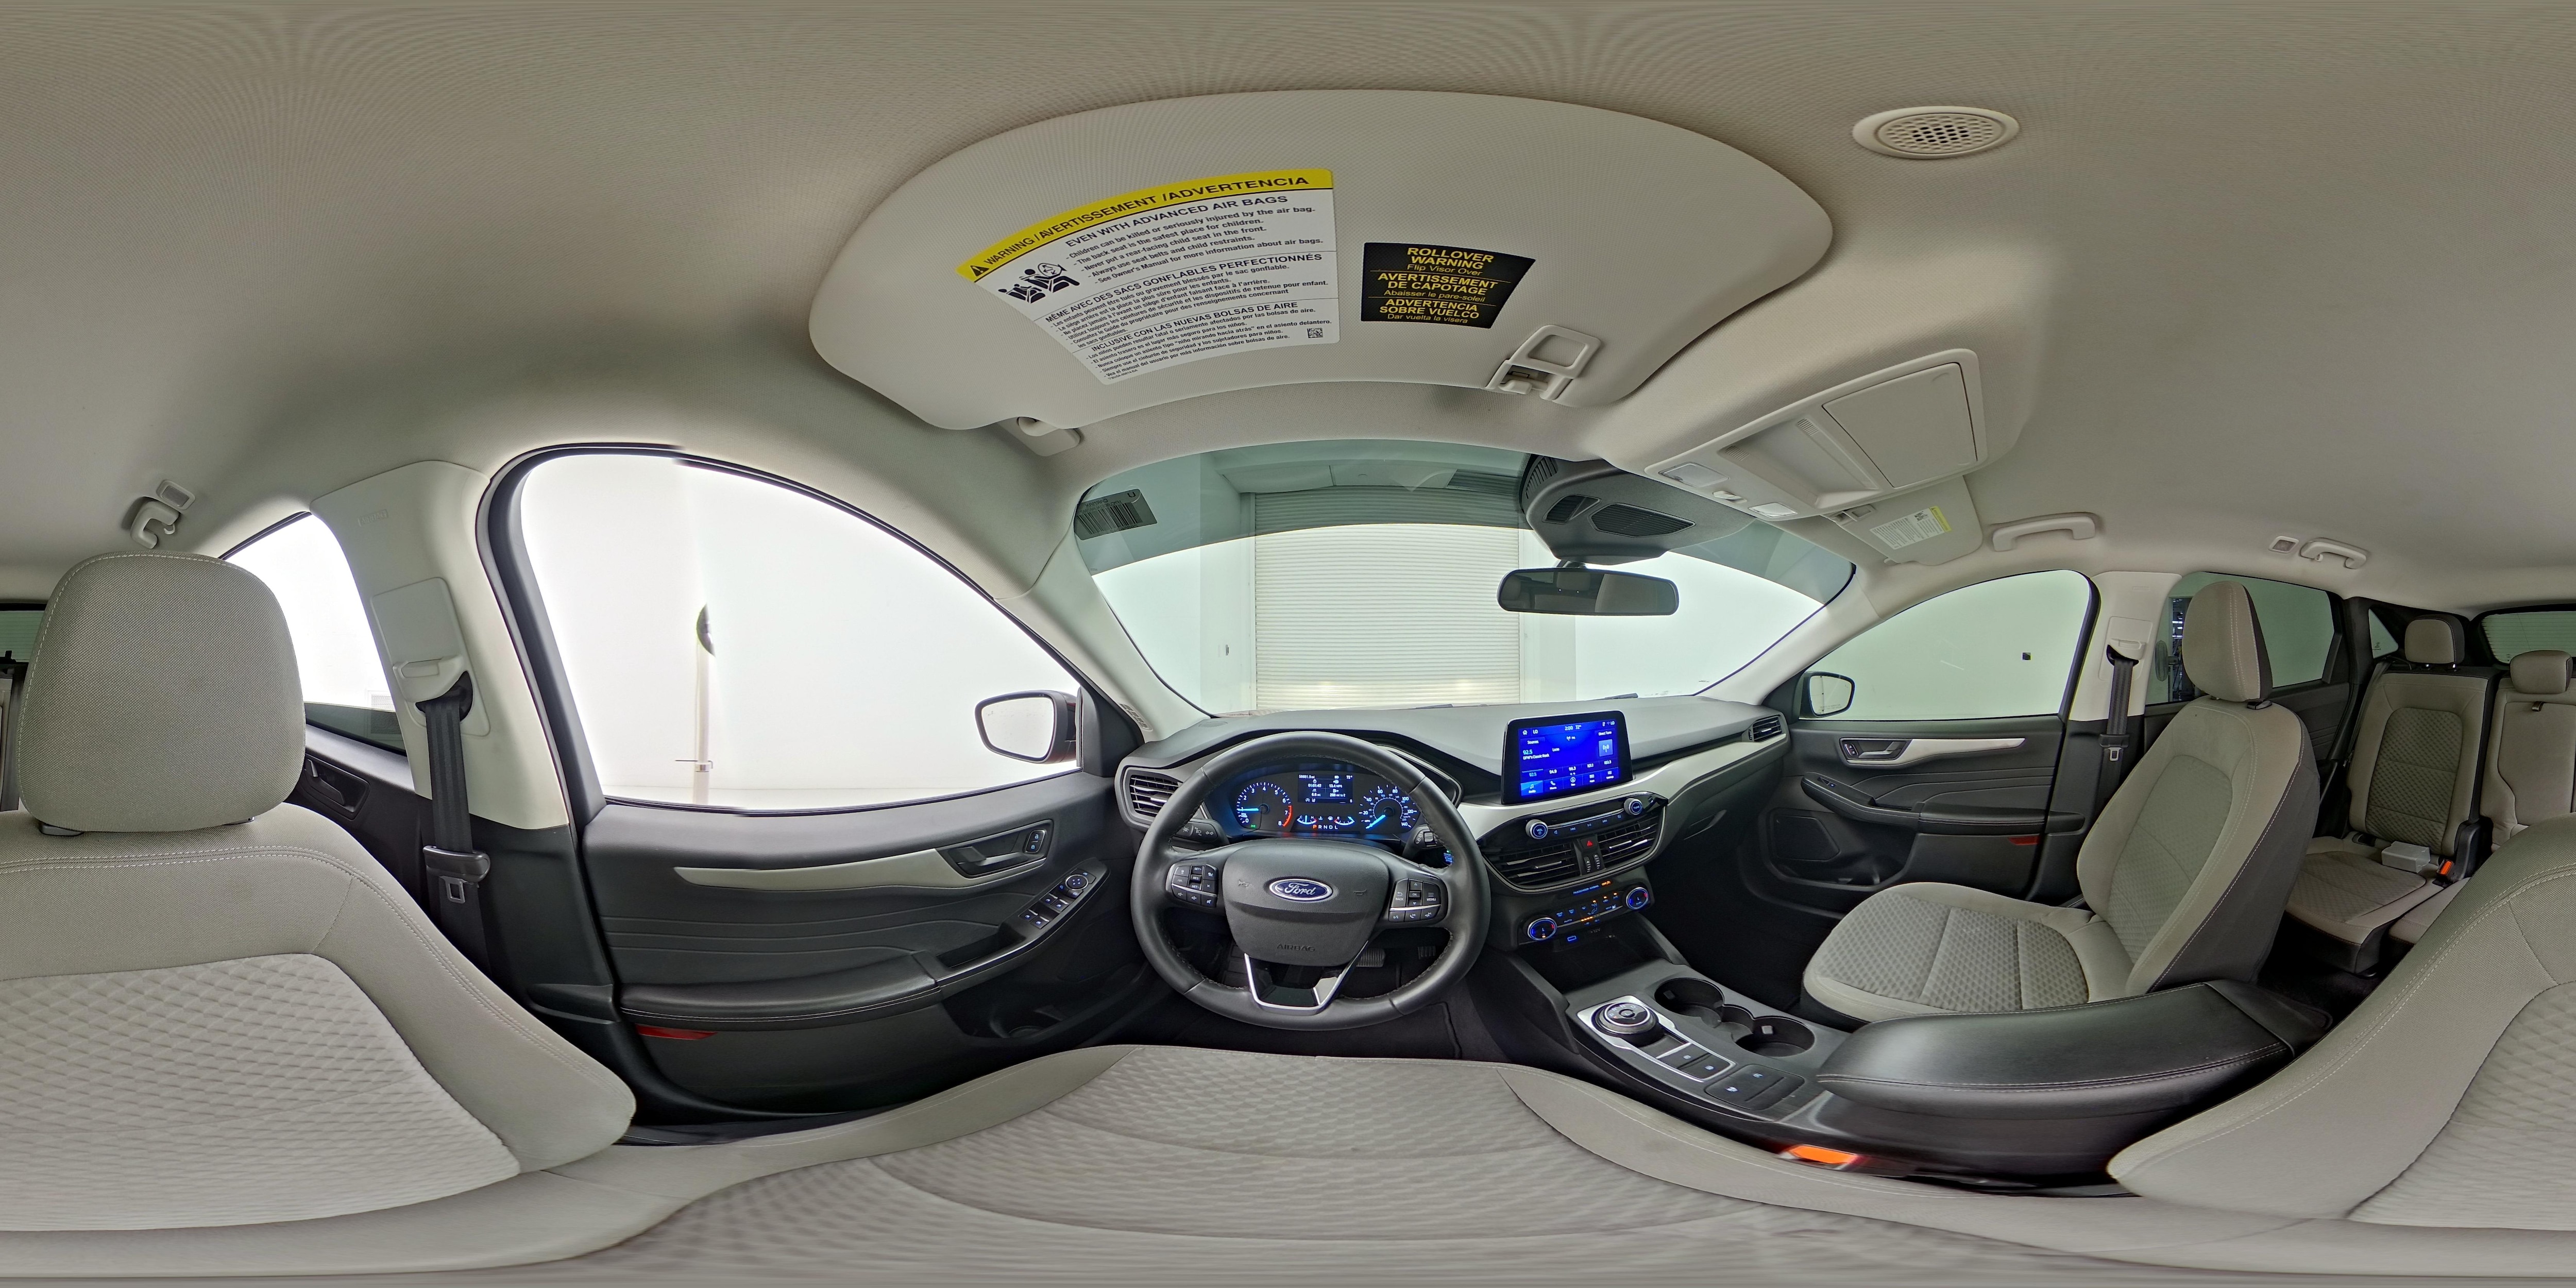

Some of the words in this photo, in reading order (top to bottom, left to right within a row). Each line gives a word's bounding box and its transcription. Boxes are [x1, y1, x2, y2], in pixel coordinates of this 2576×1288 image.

[983, 238, 1036, 265] WARNING
[1033, 195, 1157, 241] /AVERTISSEMENT
[1162, 177, 1310, 201] /ADVERTENCIA
[1064, 232, 1097, 247] EVEN
[1096, 222, 1131, 235] WITH
[1132, 205, 1209, 226] ADVANCED
[1212, 200, 1239, 210] AIR
[1241, 195, 1288, 206] BAGS
[1069, 245, 1100, 258] Children
[1126, 229, 1151, 239] killed
[1162, 218, 1204, 230] seriously
[1205, 212, 1240, 222] injured
[1090, 250, 1110, 259] back
[1110, 244, 1128, 253] seat
[1152, 231, 1179, 241] safest
[1179, 227, 1205, 236] place
[1222, 219, 1264, 228] children.
[1083, 261, 1105, 270] Never
[1105, 256, 1118, 264] put
[1125, 243, 1169, 257] rear-facing
[1169, 236, 1191, 245] child
[1191, 233, 1212, 241] seat
[1091, 265, 1117, 277] Always
[1131, 256, 1149, 264] seat
[1187, 242, 1208, 250] child
[1209, 236, 1255, 246] restraints.
[1111, 266, 1141, 278] Owner's
[1140, 258, 1169, 269] Manual
[1205, 244, 1255, 255] information
[1407, 247, 1494, 262] ROLLOVER
[1411, 256, 1484, 269] WARNING
[1045, 309, 1071, 323] MÊME
[1070, 299, 1093, 312] AVEC
[1092, 292, 1113, 302] DES
[1113, 283, 1142, 295] SACS
[1142, 265, 1217, 286] GONFLABLES
[1218, 253, 1322, 270] PERFECTIONNÉS
[1377, 273, 1498, 289] AVERTISSEMENT
[1411, 282, 1487, 295] CAPOTAGE
[1385, 298, 1477, 311] ADVERTENCIA
[1438, 293, 1485, 302] pare-soleil
[1429, 308, 1479, 318] VUELCO
[1091, 333, 1133, 351] INCLUSIVE
[1133, 328, 1154, 337] CON
[1153, 323, 1172, 332] LAS
[1173, 314, 1212, 327] NUEVAS
[1213, 307, 1255, 318] BOLSAS
[1273, 301, 1298, 310] AIRE
[1284, 883, 1316, 895] Ford
[1277, 943, 1315, 952] AIRBAG
